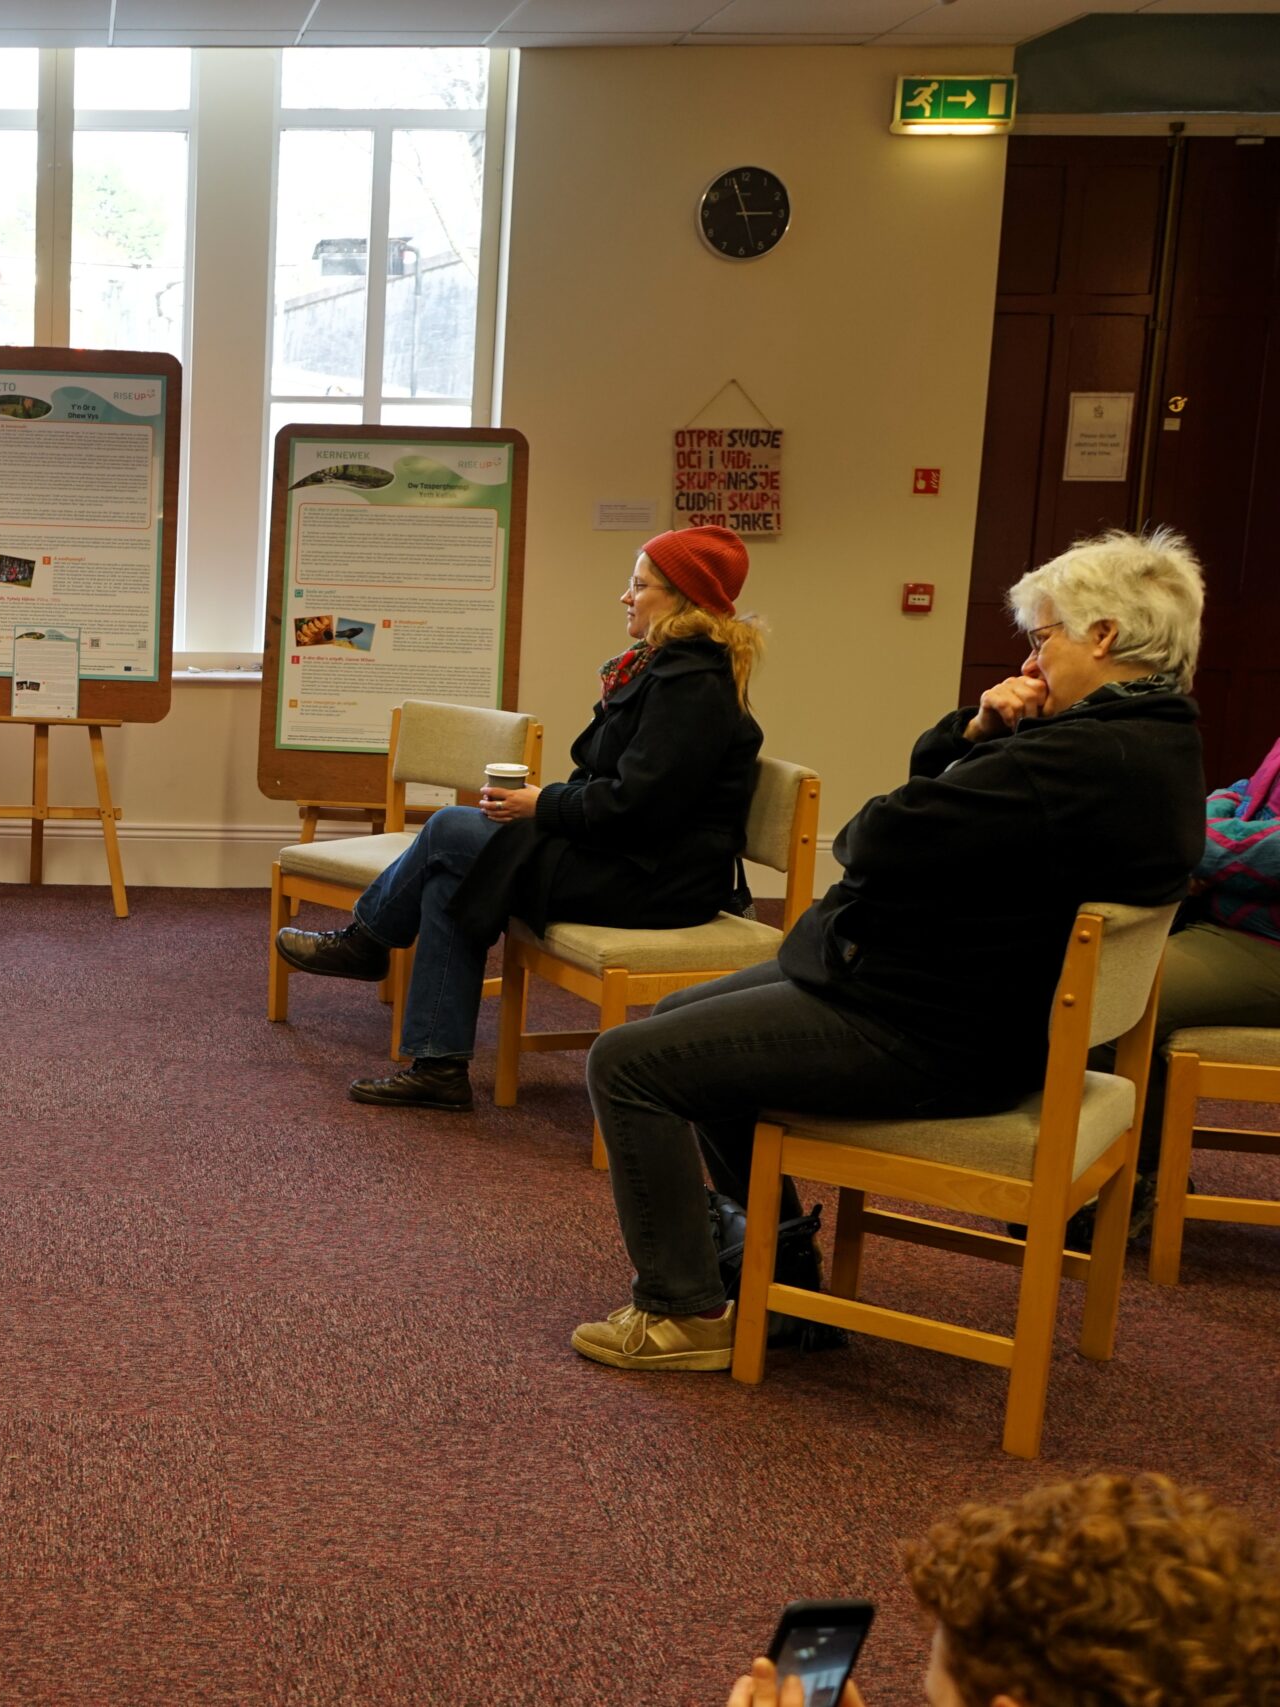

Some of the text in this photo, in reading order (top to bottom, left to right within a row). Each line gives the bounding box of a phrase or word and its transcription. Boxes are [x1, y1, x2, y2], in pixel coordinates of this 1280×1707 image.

[741, 172, 751, 182] 12
[724, 178, 732, 186] 11
[774, 192, 781, 201] 2
[703, 210, 710, 218] 9
[778, 209, 785, 218] 3
[707, 228, 714, 238] 8
[770, 228, 778, 237] 4
[720, 241, 728, 250] 7
[757, 241, 765, 250] 5
[738, 246, 745, 255] 6
[727, 429, 783, 449] SVOJE
[316, 450, 370, 460] KERNEWEK
[727, 492, 781, 511] SKUPA
